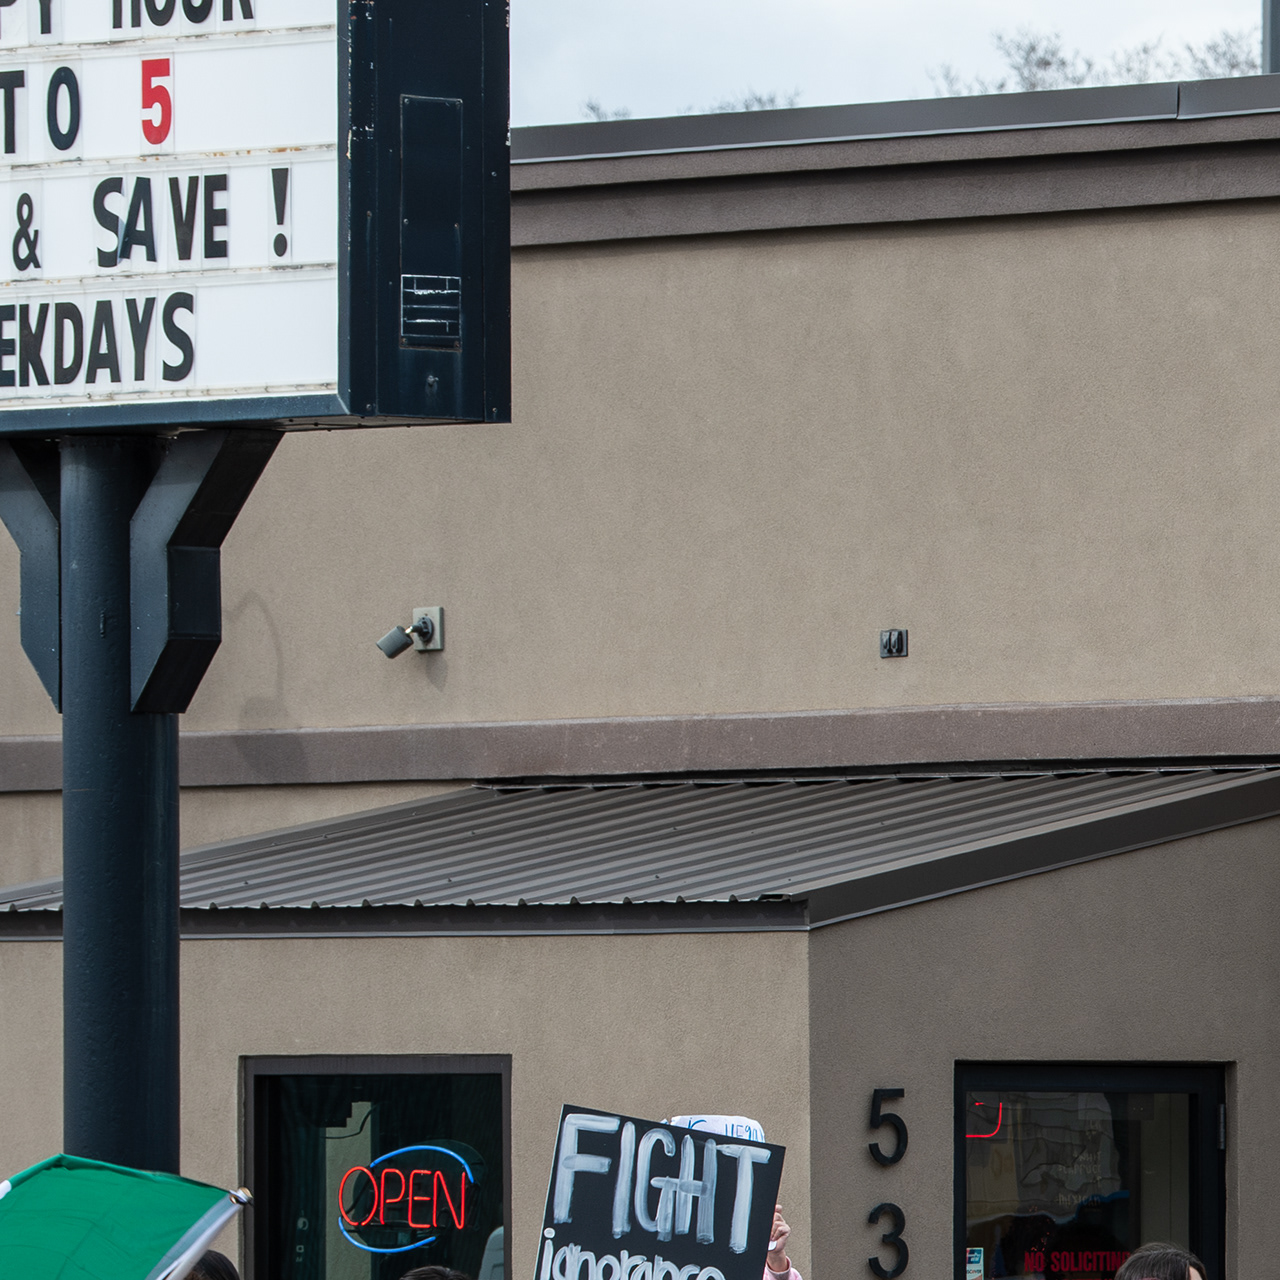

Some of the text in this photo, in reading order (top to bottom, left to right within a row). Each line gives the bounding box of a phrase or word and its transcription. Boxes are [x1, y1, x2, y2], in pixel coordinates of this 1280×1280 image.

[0, 58, 172, 154] TO 5
[12, 193, 41, 271] &
[93, 173, 228, 268] SAVE
[338, 1165, 467, 1230] OPEN
[553, 1113, 771, 1254] FIGHT
[1024, 1251, 1046, 1272] NO
